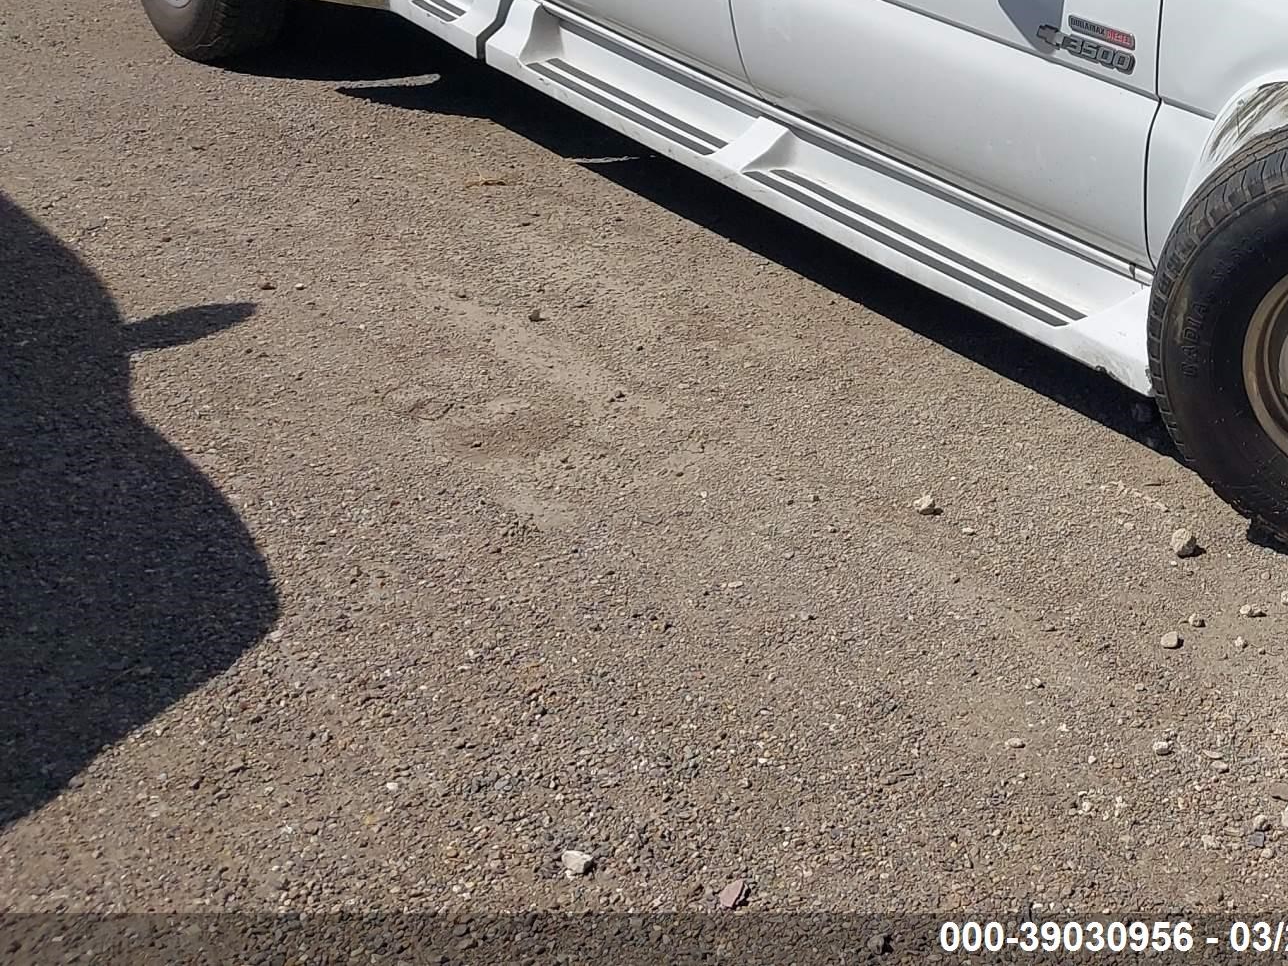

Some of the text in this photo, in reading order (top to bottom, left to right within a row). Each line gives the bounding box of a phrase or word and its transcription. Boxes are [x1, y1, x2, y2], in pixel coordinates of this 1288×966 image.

[1071, 17, 1130, 46] DURAMAX DIESEL
[1064, 34, 1133, 72] 3500
